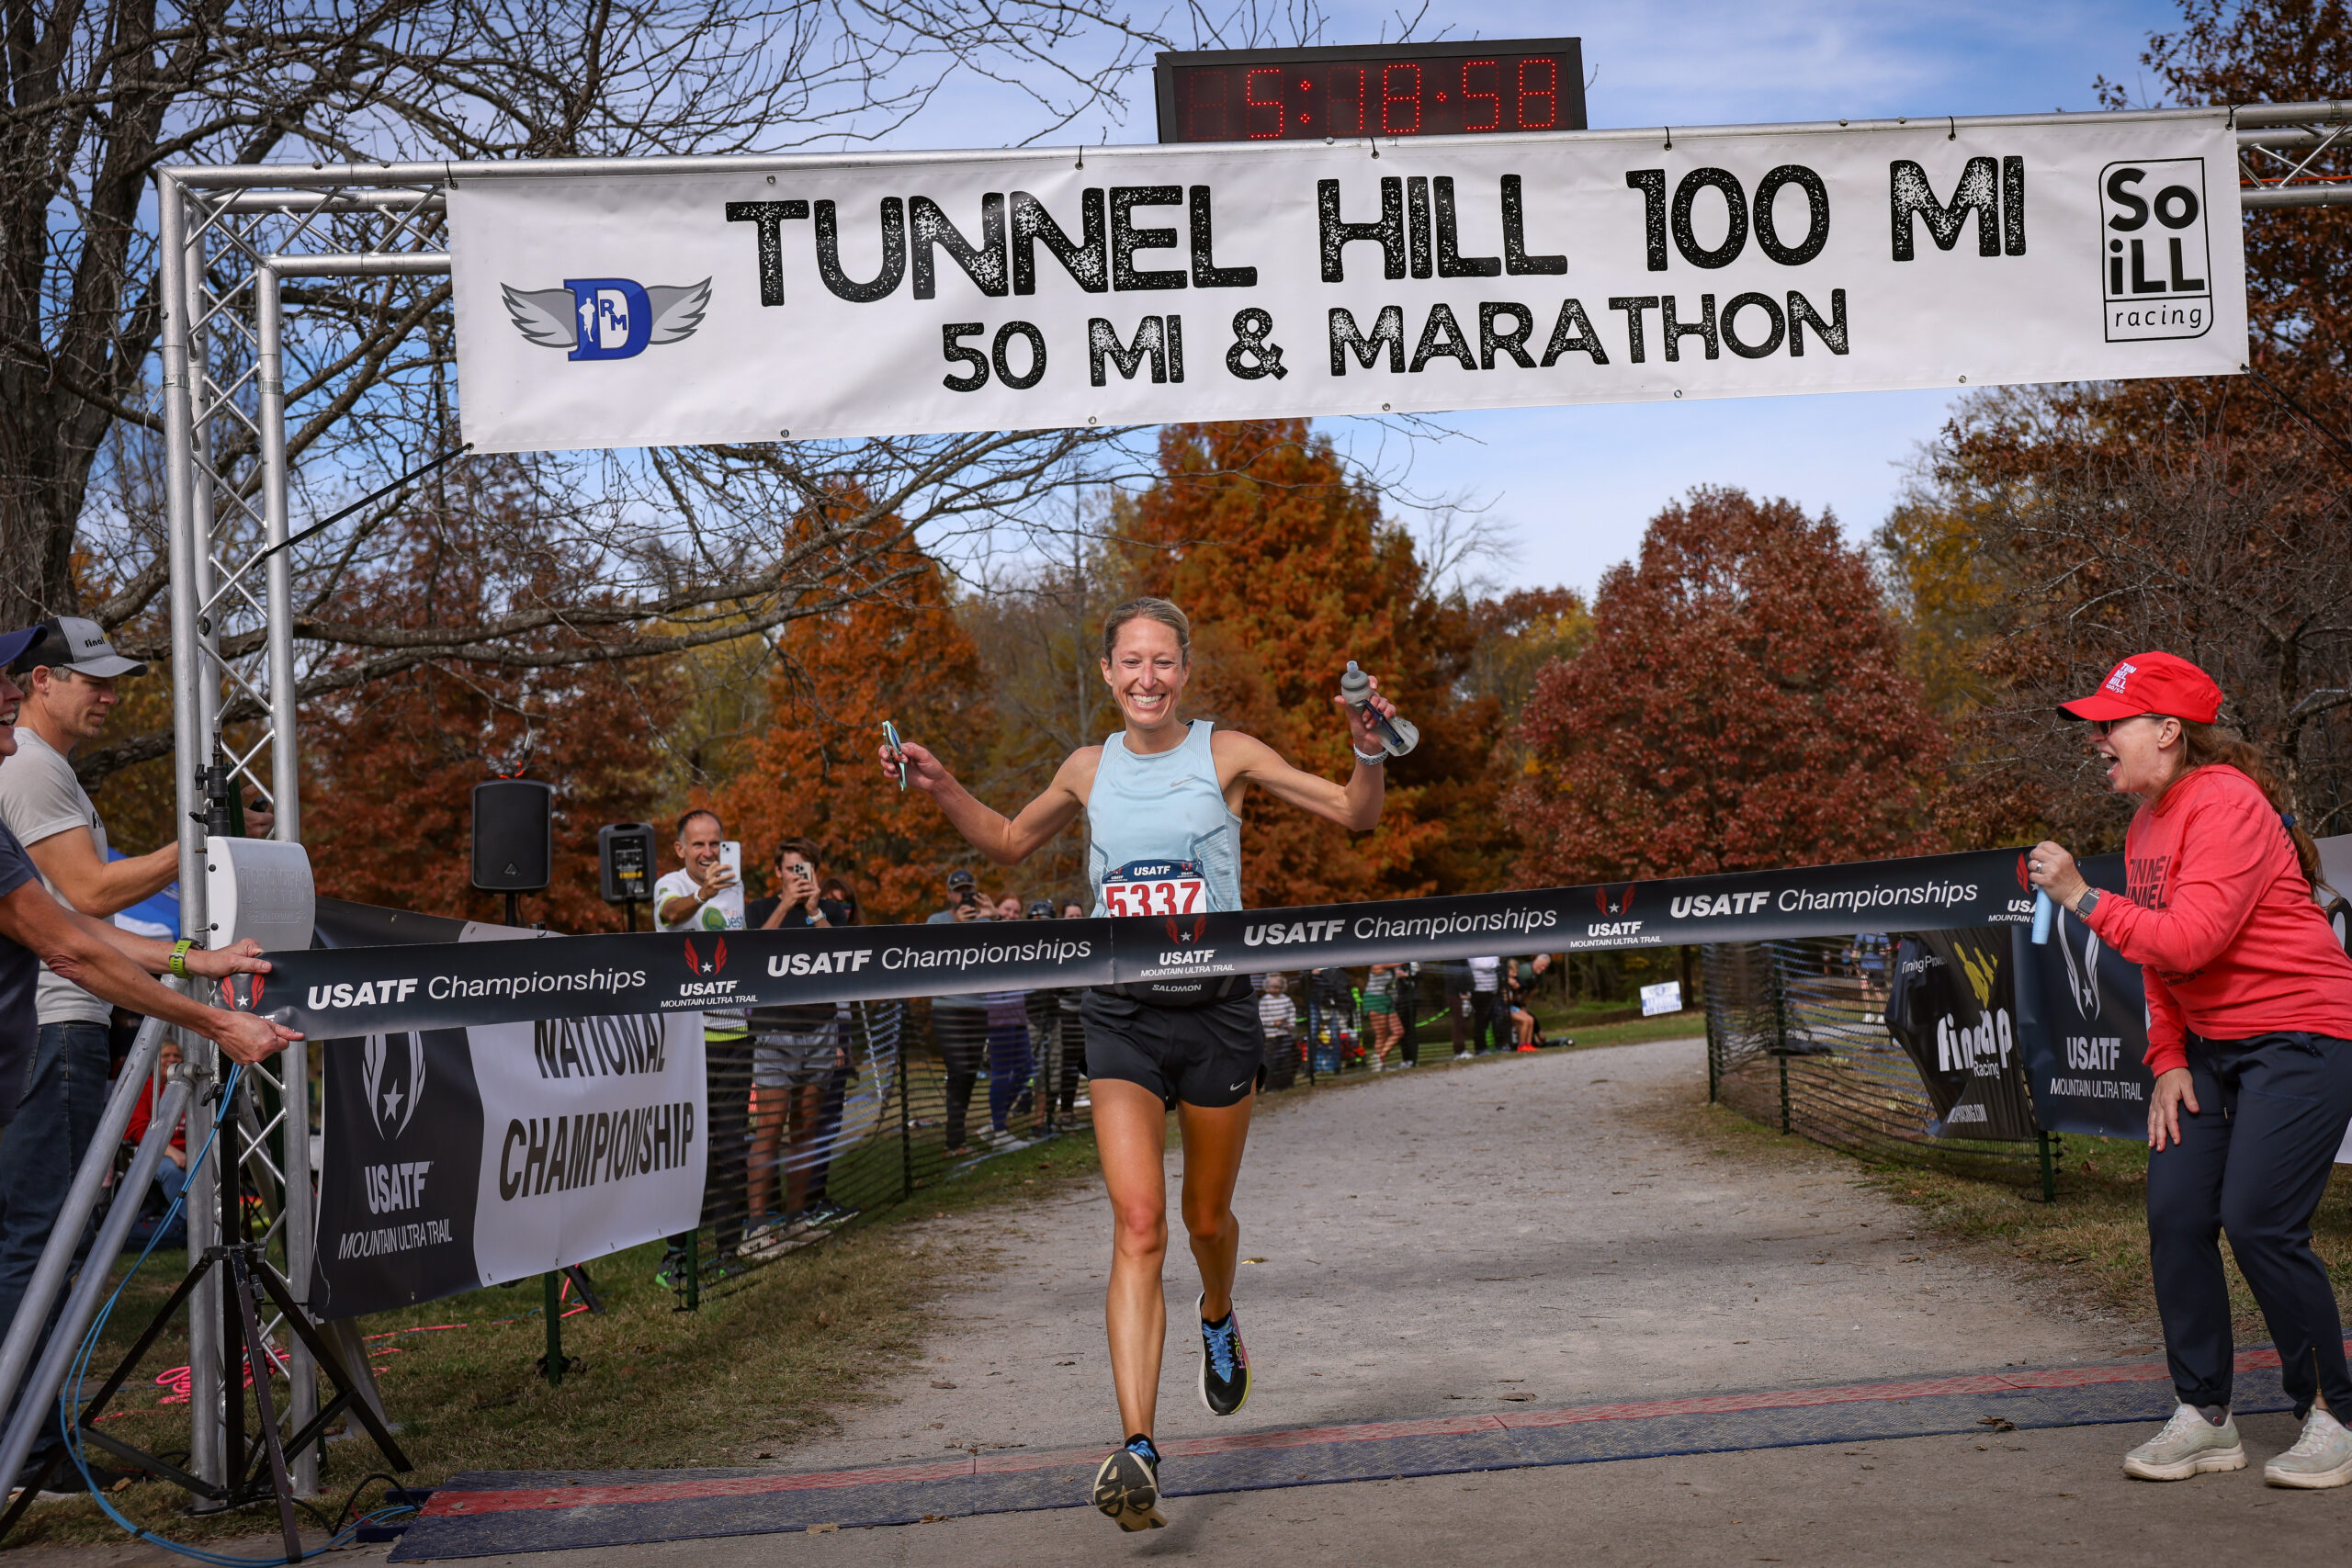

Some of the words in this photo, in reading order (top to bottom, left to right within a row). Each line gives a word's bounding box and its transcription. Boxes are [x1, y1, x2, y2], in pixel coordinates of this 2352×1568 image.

[2107, 168, 2199, 231] So
[725, 185, 1257, 307] TUNNEL
[1317, 174, 1567, 283] HILL
[1626, 164, 1830, 271] 100
[1890, 156, 2026, 261] MI
[2116, 305, 2201, 328] racing
[942, 321, 1046, 392] 50
[1089, 314, 1184, 387] MI
[1226, 307, 1288, 380] &
[1329, 288, 1849, 376] MARATHON
[1134, 865, 1170, 876] USATF
[1106, 882, 1201, 918] 5337
[1670, 891, 1770, 919] USATF
[1778, 881, 1978, 912] Championships
[1243, 919, 1345, 946] USATF
[1354, 908, 1556, 940] Championships
[1588, 921, 1642, 937] USATF
[1988, 914, 2031, 923] MOUNTAIN
[1159, 950, 1215, 965] USATF
[1570, 939, 1611, 948] MOUNTAIN
[1613, 937, 1638, 945] ULTRA
[1640, 935, 1662, 943] TRAIL
[767, 950, 872, 977] USATF
[881, 939, 1091, 970] Championships
[1141, 967, 1183, 977] MOUNTAIN
[1184, 965, 1210, 974] ULTRA
[1213, 964, 1235, 972] TRAIL
[308, 978, 417, 1010] USATF
[428, 967, 646, 1001] Championships
[661, 998, 705, 1008] MOUNTAIN
[707, 996, 732, 1005] ULTRA
[735, 995, 758, 1003] TRAIL
[680, 980, 737, 997] USATF
[1152, 984, 1201, 992] SALOMON
[535, 1013, 665, 1078] NATIONAL
[2066, 1036, 2120, 1070] USATF
[1973, 1060, 2000, 1079] Racing
[2050, 1077, 2091, 1097] MOUNTAIN
[2092, 1080, 2119, 1099] ULTRA
[2120, 1082, 2143, 1100] TRAIL
[499, 1102, 694, 1201] CHAMPIONSHIP
[365, 1161, 430, 1214] USATF
[338, 1225, 397, 1260] MOUNTAIN
[397, 1223, 426, 1252] ULTRA
[426, 1219, 452, 1247] TRAIL
[1234, 1337, 1245, 1368] HOK
